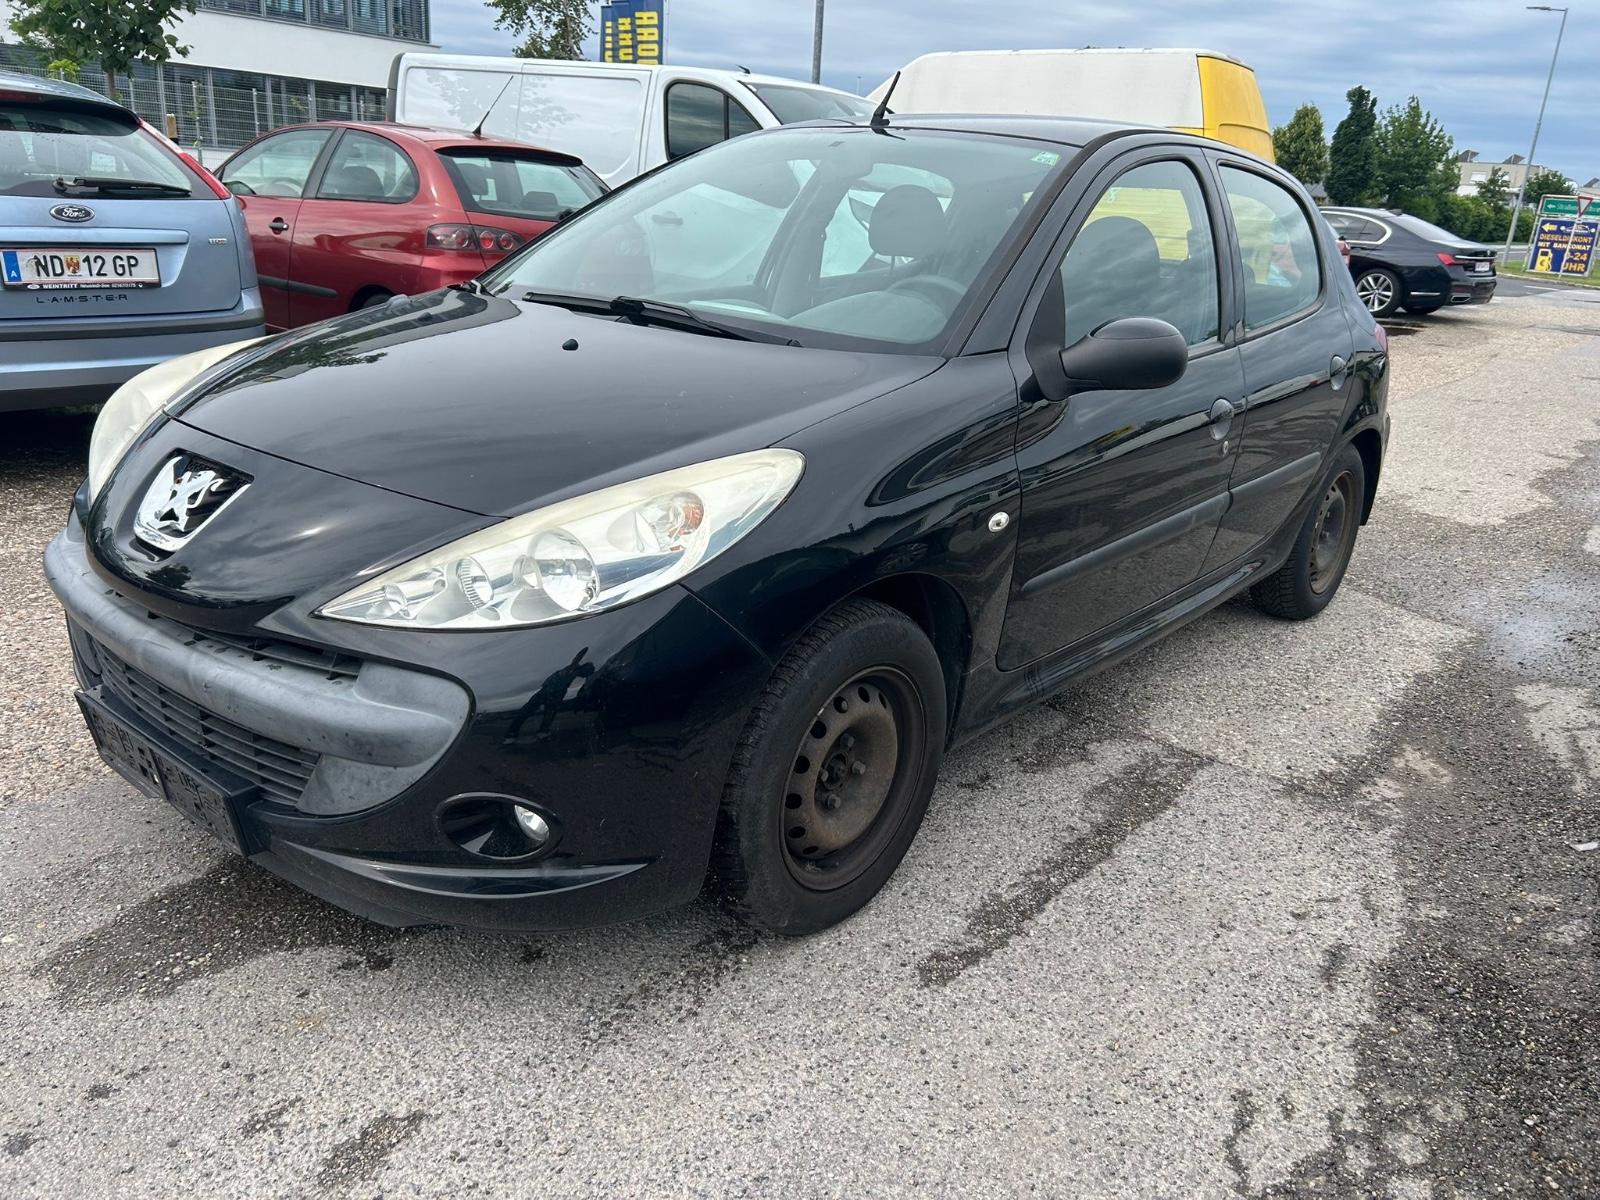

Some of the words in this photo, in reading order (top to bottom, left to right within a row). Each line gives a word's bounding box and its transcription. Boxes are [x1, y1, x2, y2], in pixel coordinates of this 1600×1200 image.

[62, 207, 86, 218] Ford
[1539, 233, 1593, 243] DIESELDIKONT
[34, 255, 64, 277] ND
[82, 255, 107, 277] 12
[113, 255, 139, 277] GP
[10, 270, 18, 278] A
